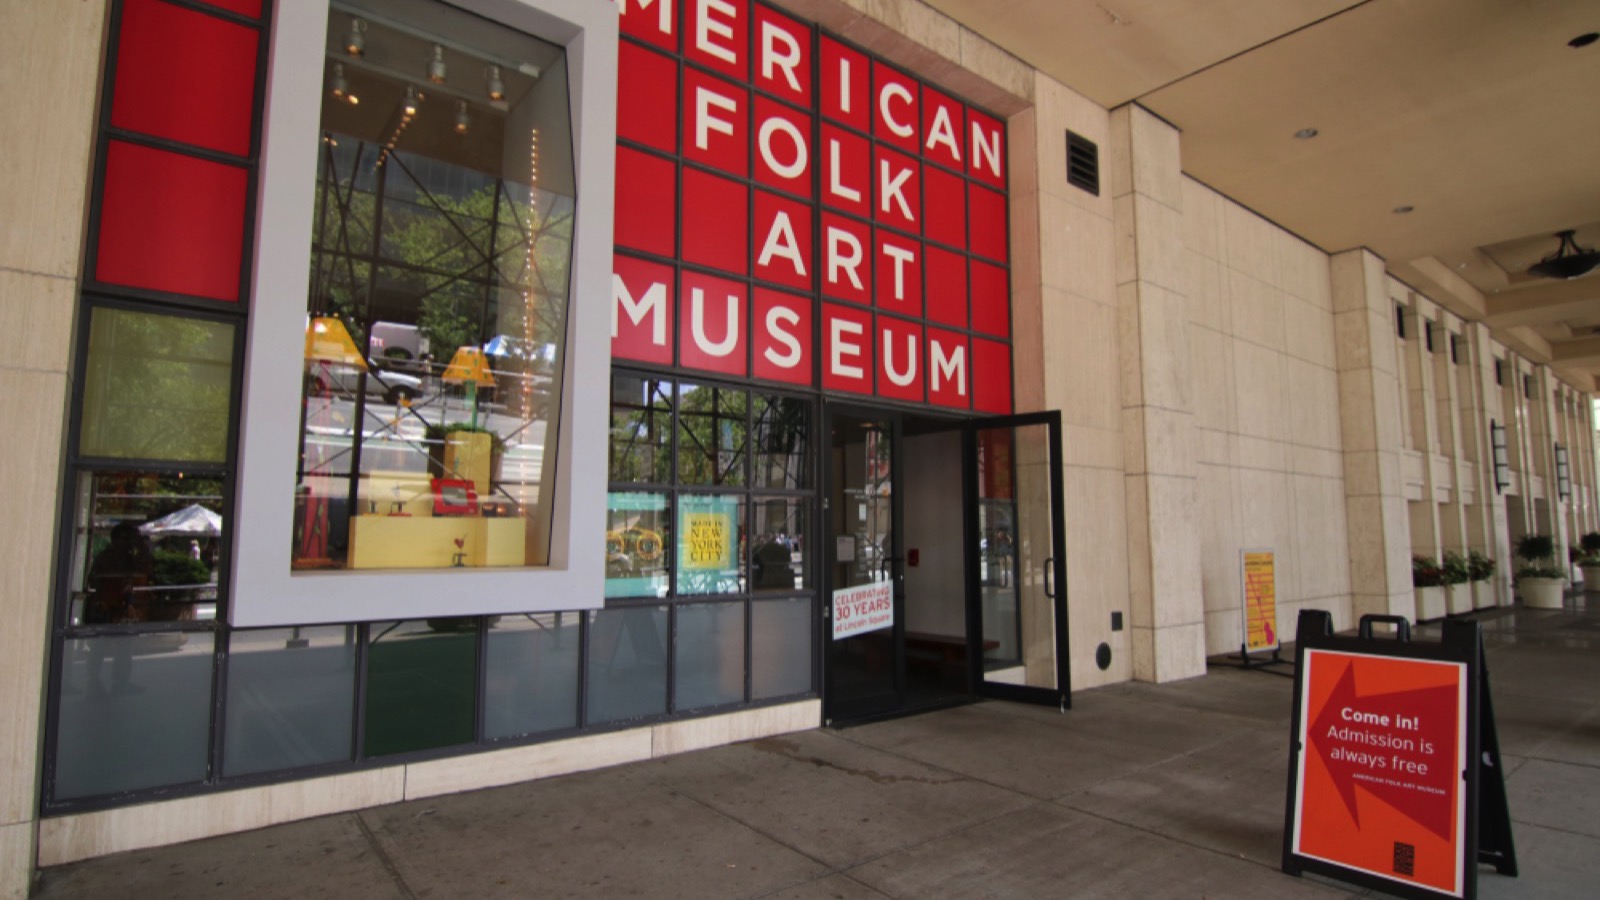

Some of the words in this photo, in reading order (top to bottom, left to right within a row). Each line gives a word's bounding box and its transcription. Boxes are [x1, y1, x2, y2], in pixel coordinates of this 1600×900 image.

[696, 86, 914, 221] FOLK
[758, 211, 914, 300] ART
[611, 273, 965, 395] MUSEUM
[691, 528, 722, 538] NEW
[691, 539, 722, 550] YORK
[691, 551, 722, 562] CITY
[835, 586, 889, 606] CELEBRATING
[836, 605, 851, 621] 30
[854, 597, 891, 616] YEARS
[845, 619, 868, 631] Lincoln
[1341, 707, 1390, 726] Come
[1396, 714, 1419, 731] in!
[1327, 725, 1414, 751] Admission
[1420, 738, 1434, 755] is
[1331, 747, 1386, 769] always
[1392, 755, 1428, 775] free
[1352, 773, 1385, 784] AMERICAN
[1385, 778, 1401, 787] FOLK
[1403, 782, 1416, 790] ART
[1417, 785, 1446, 795] MUSEUM
